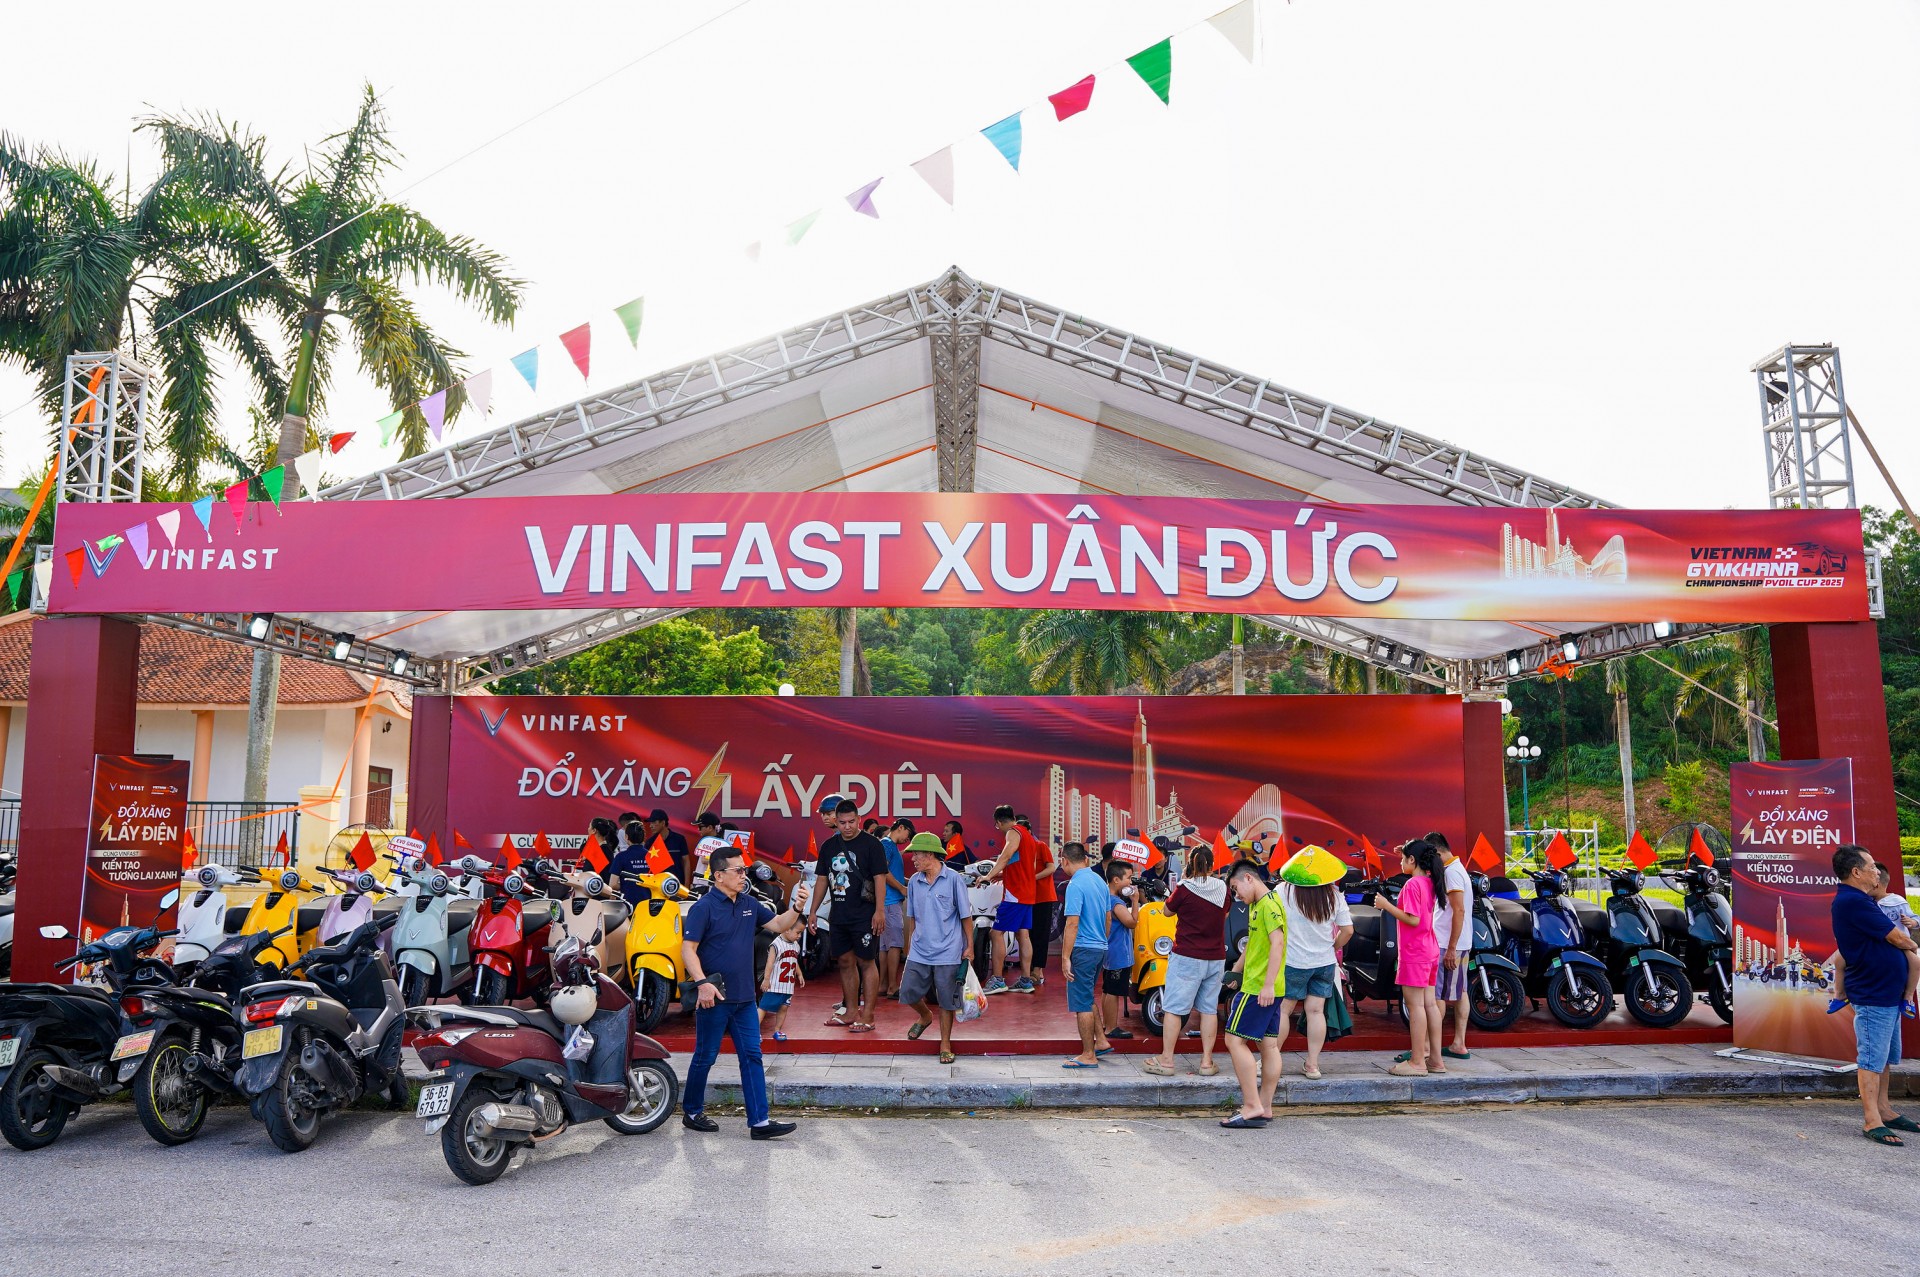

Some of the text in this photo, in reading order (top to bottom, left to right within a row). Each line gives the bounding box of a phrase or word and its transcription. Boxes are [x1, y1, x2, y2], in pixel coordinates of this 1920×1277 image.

[524, 503, 1399, 602] VINFAST XUÂN ĐỨC
[1690, 547, 1773, 560] VIETNAM
[1686, 562, 1799, 577] GYMKHANA
[1685, 578, 1842, 588] CHAMPIONSHIP PVOIL CUP 2025
[521, 714, 628, 732] VINFAST
[517, 751, 692, 797] ĐỔI XĂNG
[721, 753, 826, 818] LẤY
[118, 801, 171, 818] ĐỔI XĂNG
[1759, 804, 1829, 822] ĐỔI XĂNG
[107, 818, 178, 846] LẤY ĐIỆN
[1750, 822, 1841, 849] LẤY ĐIỆN
[1122, 843, 1143, 854] MOTIO
[101, 858, 141, 872] KIẾN TẠO
[1747, 860, 1793, 876] KIẾN TẠO
[109, 871, 178, 881] TƯƠNG LAI XANH
[1756, 874, 1841, 886] TƯƠNG LAI XAN
[779, 961, 797, 984] 23
[424, 1085, 449, 1101] 36-B3
[419, 1098, 448, 1116] 679.72
